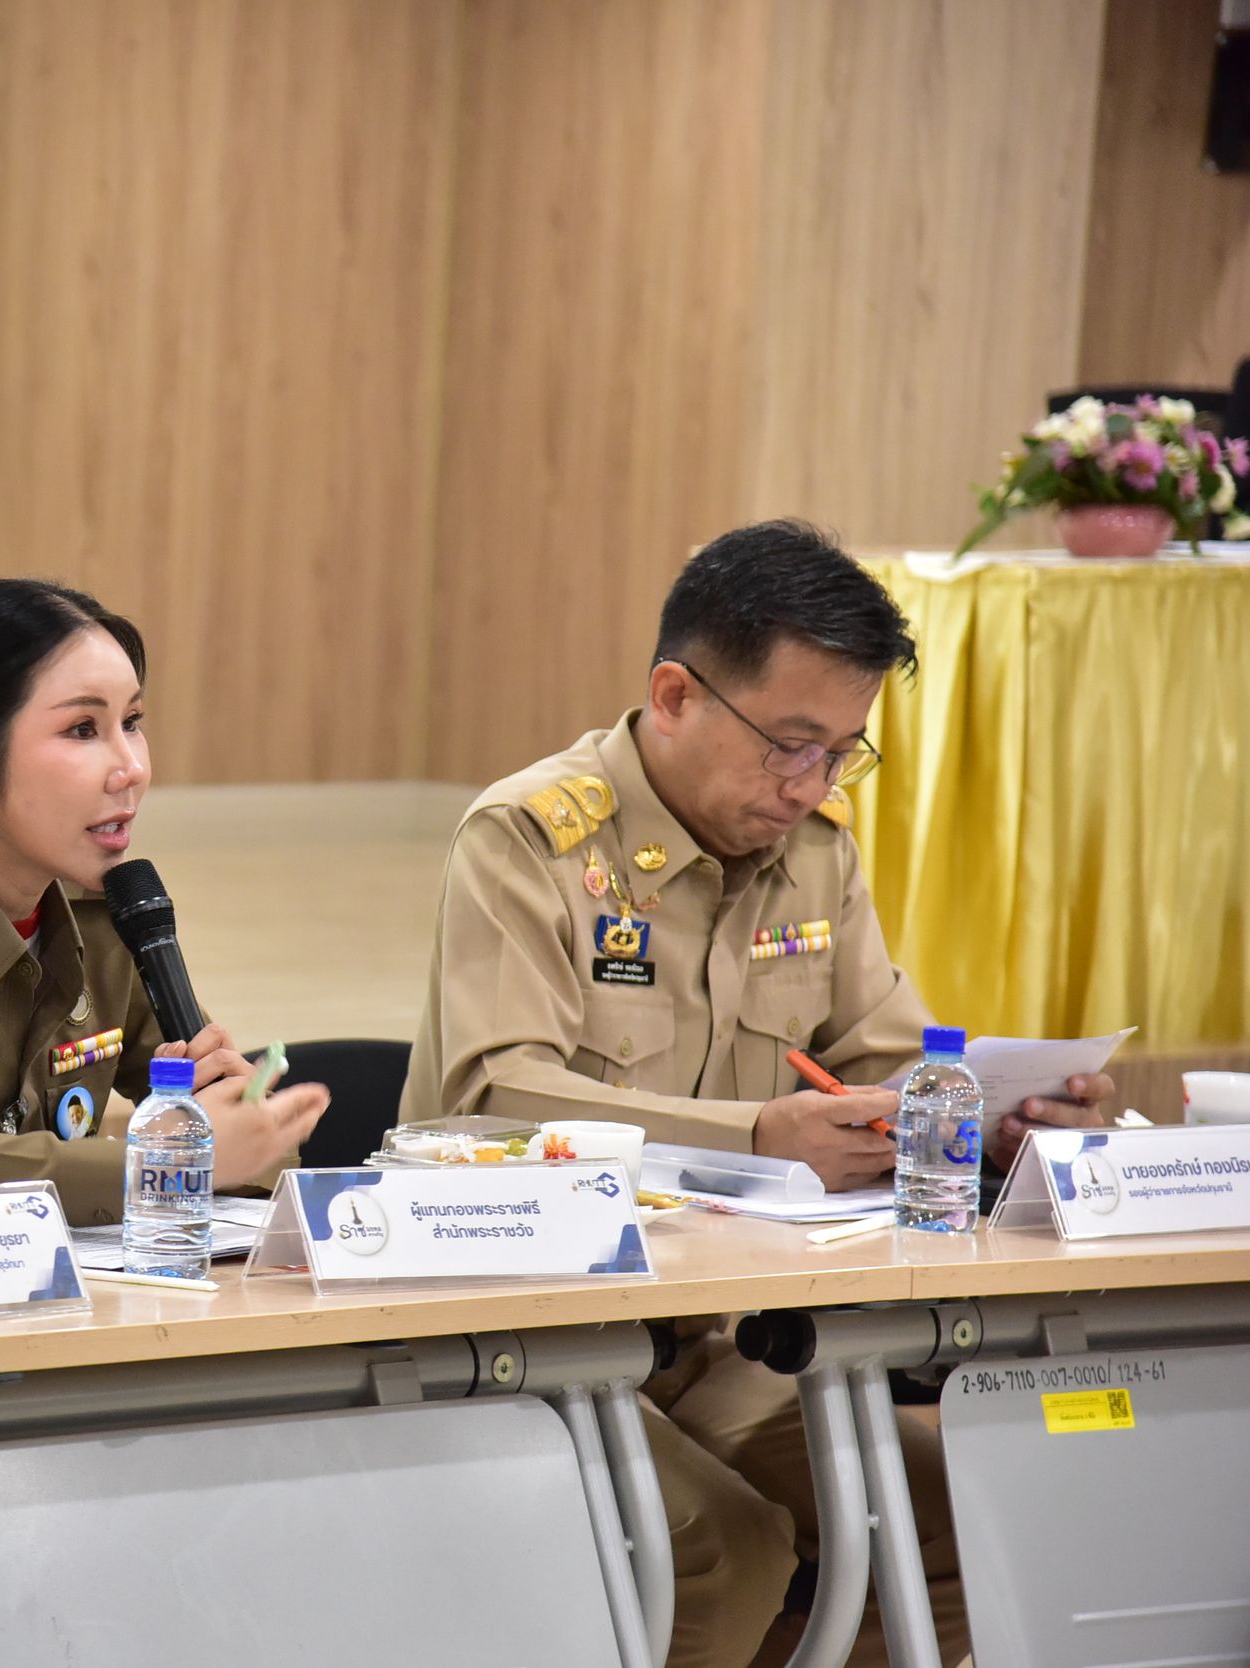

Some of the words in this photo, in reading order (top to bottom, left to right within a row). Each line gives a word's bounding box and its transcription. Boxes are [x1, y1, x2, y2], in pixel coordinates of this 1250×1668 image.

[1122, 1157, 1201, 1180] นายองครักษ์
[1204, 1156, 1250, 1175] ทองนิร
[141, 1193, 195, 1203] DRINKING
[410, 1199, 541, 1221] ผู้แทนกองพระราชพิธี
[432, 1222, 534, 1239] สำนักพระราชวัง
